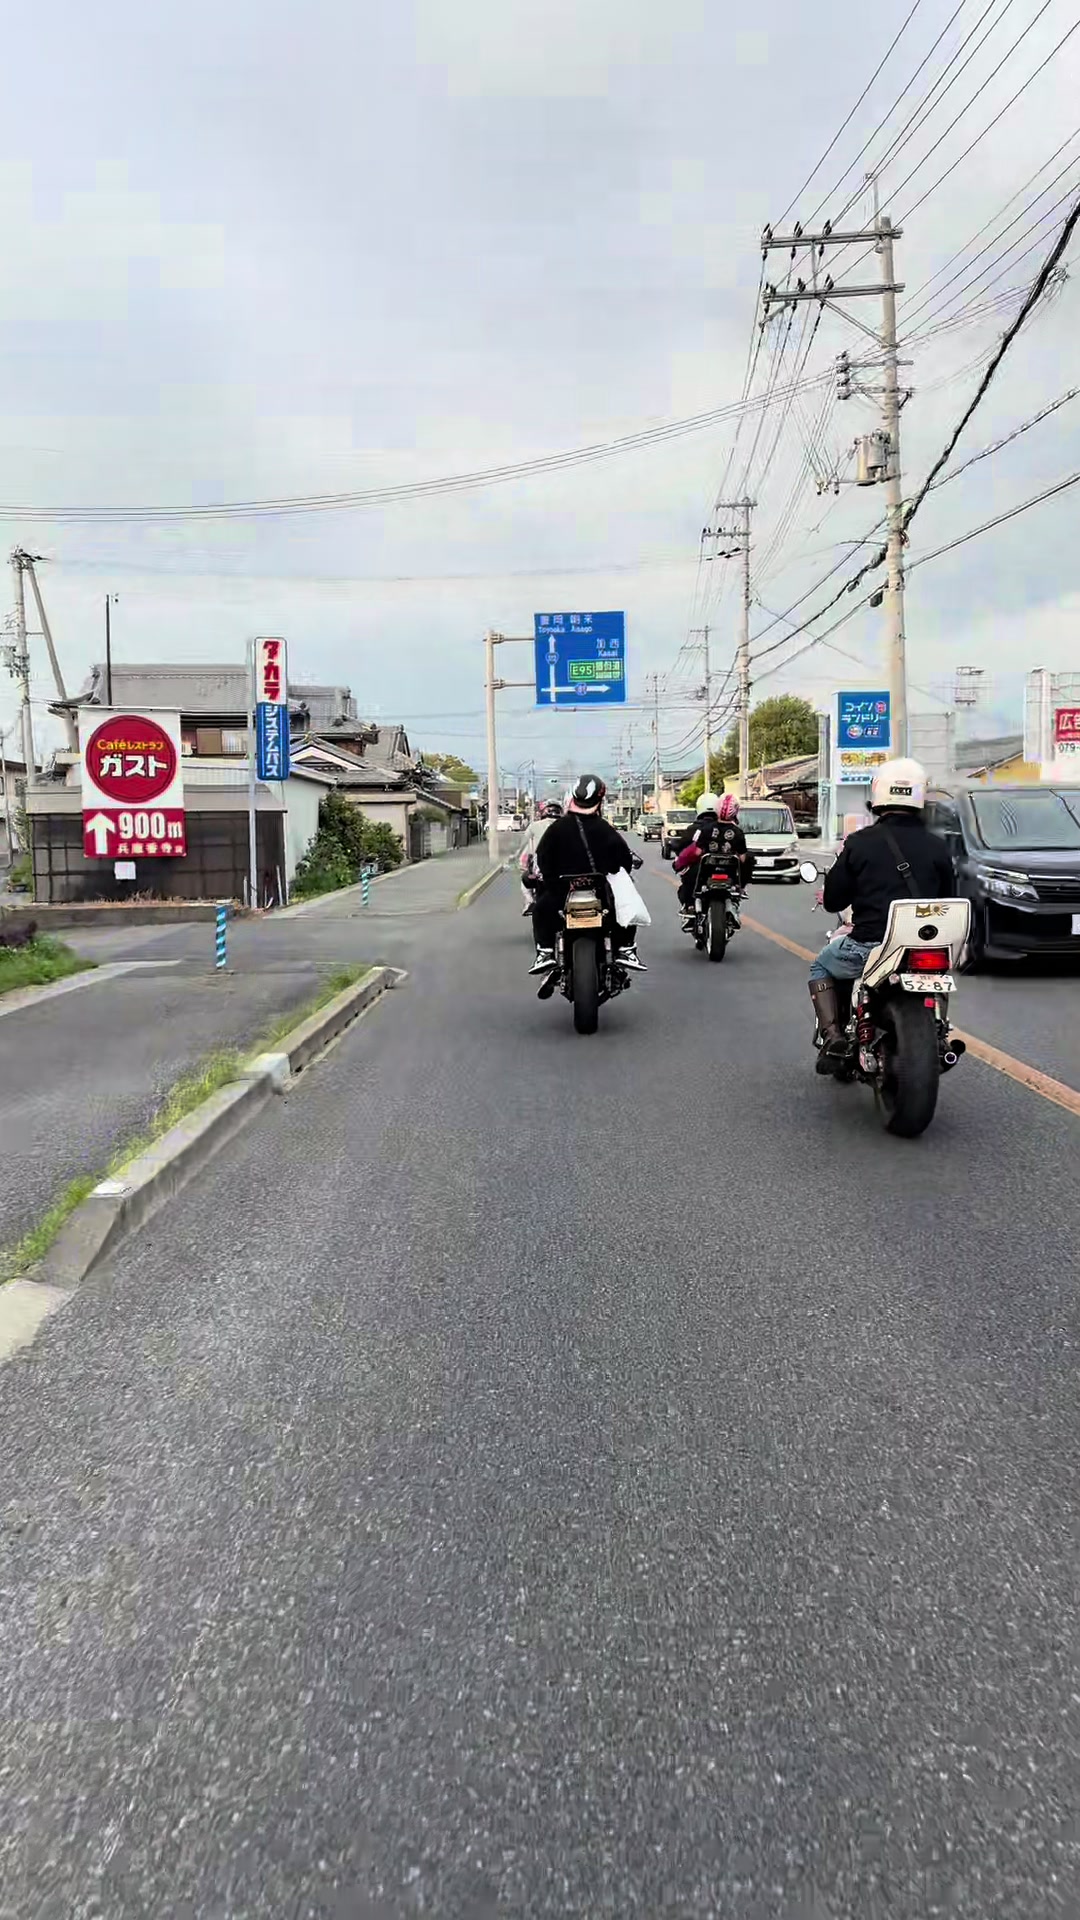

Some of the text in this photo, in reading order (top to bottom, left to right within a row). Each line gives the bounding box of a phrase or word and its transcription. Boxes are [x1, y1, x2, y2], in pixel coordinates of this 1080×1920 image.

[263, 641, 280, 700] タカラ
[572, 666, 592, 676] E95
[841, 713, 887, 723] ランドリー
[845, 702, 873, 712] コイン
[265, 705, 279, 777] システムバス
[100, 754, 167, 778] ガスト
[118, 812, 183, 839] 900m
